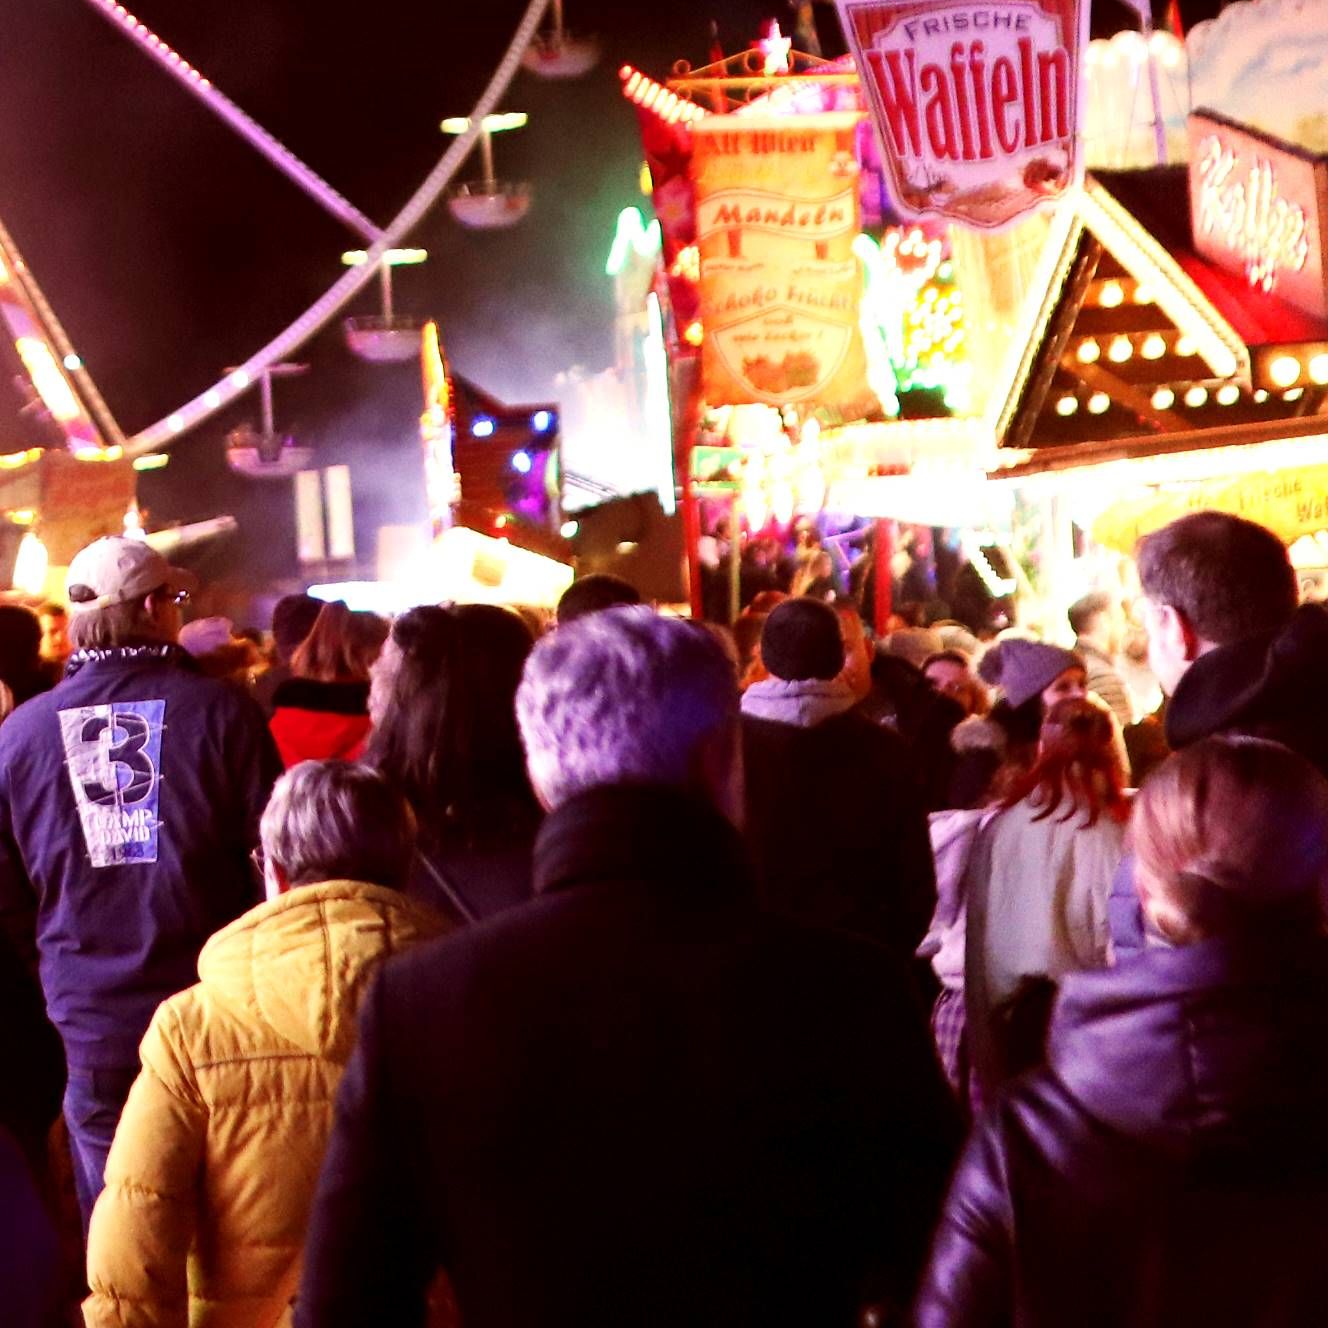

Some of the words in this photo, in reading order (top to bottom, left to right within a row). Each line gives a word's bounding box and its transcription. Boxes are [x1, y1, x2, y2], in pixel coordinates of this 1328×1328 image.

[903, 10, 1033, 42] FRISCHE
[865, 35, 1071, 162] Waffeln
[712, 202, 846, 228] Mandeln
[80, 712, 155, 806] 3
